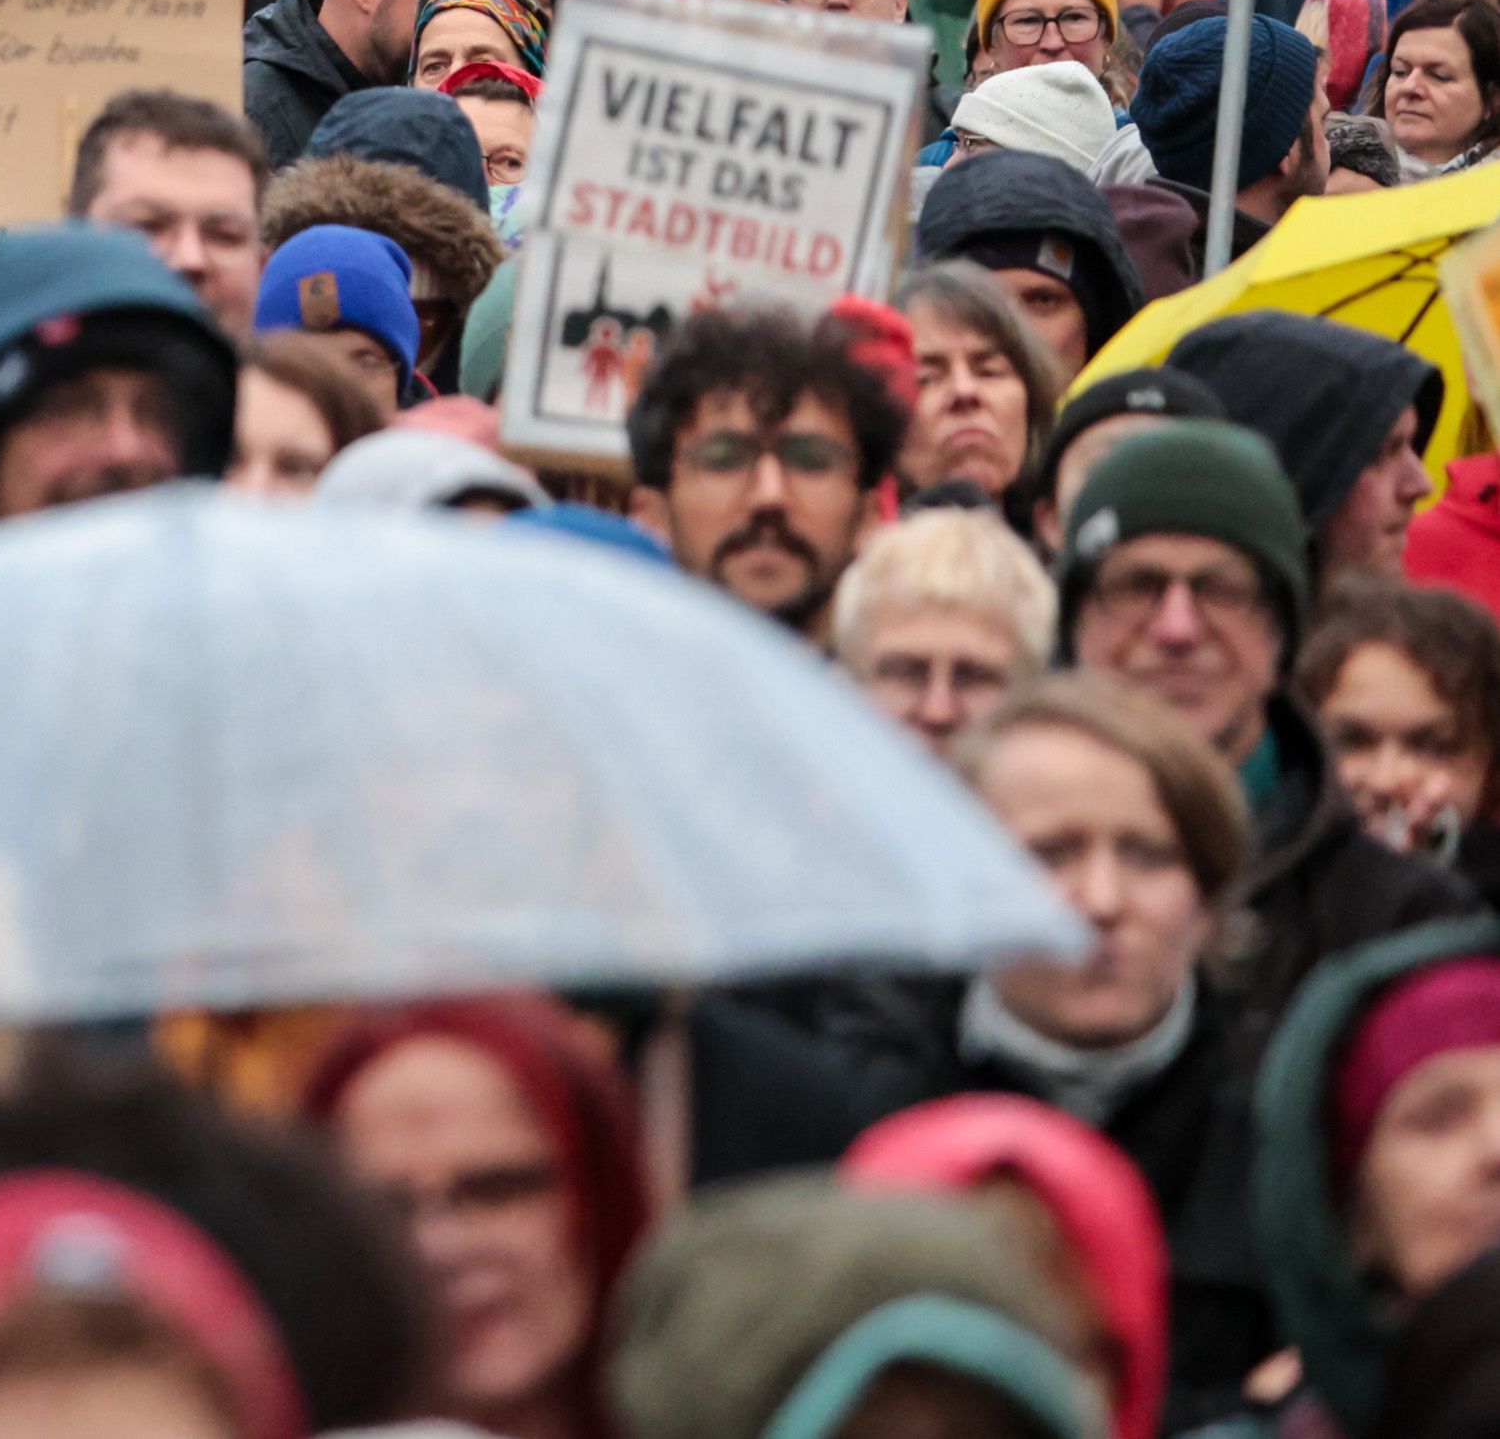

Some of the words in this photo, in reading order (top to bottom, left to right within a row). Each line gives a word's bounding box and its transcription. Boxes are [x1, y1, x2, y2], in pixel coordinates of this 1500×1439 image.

[602, 66, 862, 171] VIELFALT
[626, 139, 699, 190] IST
[711, 157, 806, 213] DAS
[567, 179, 845, 278] STADTBILD
